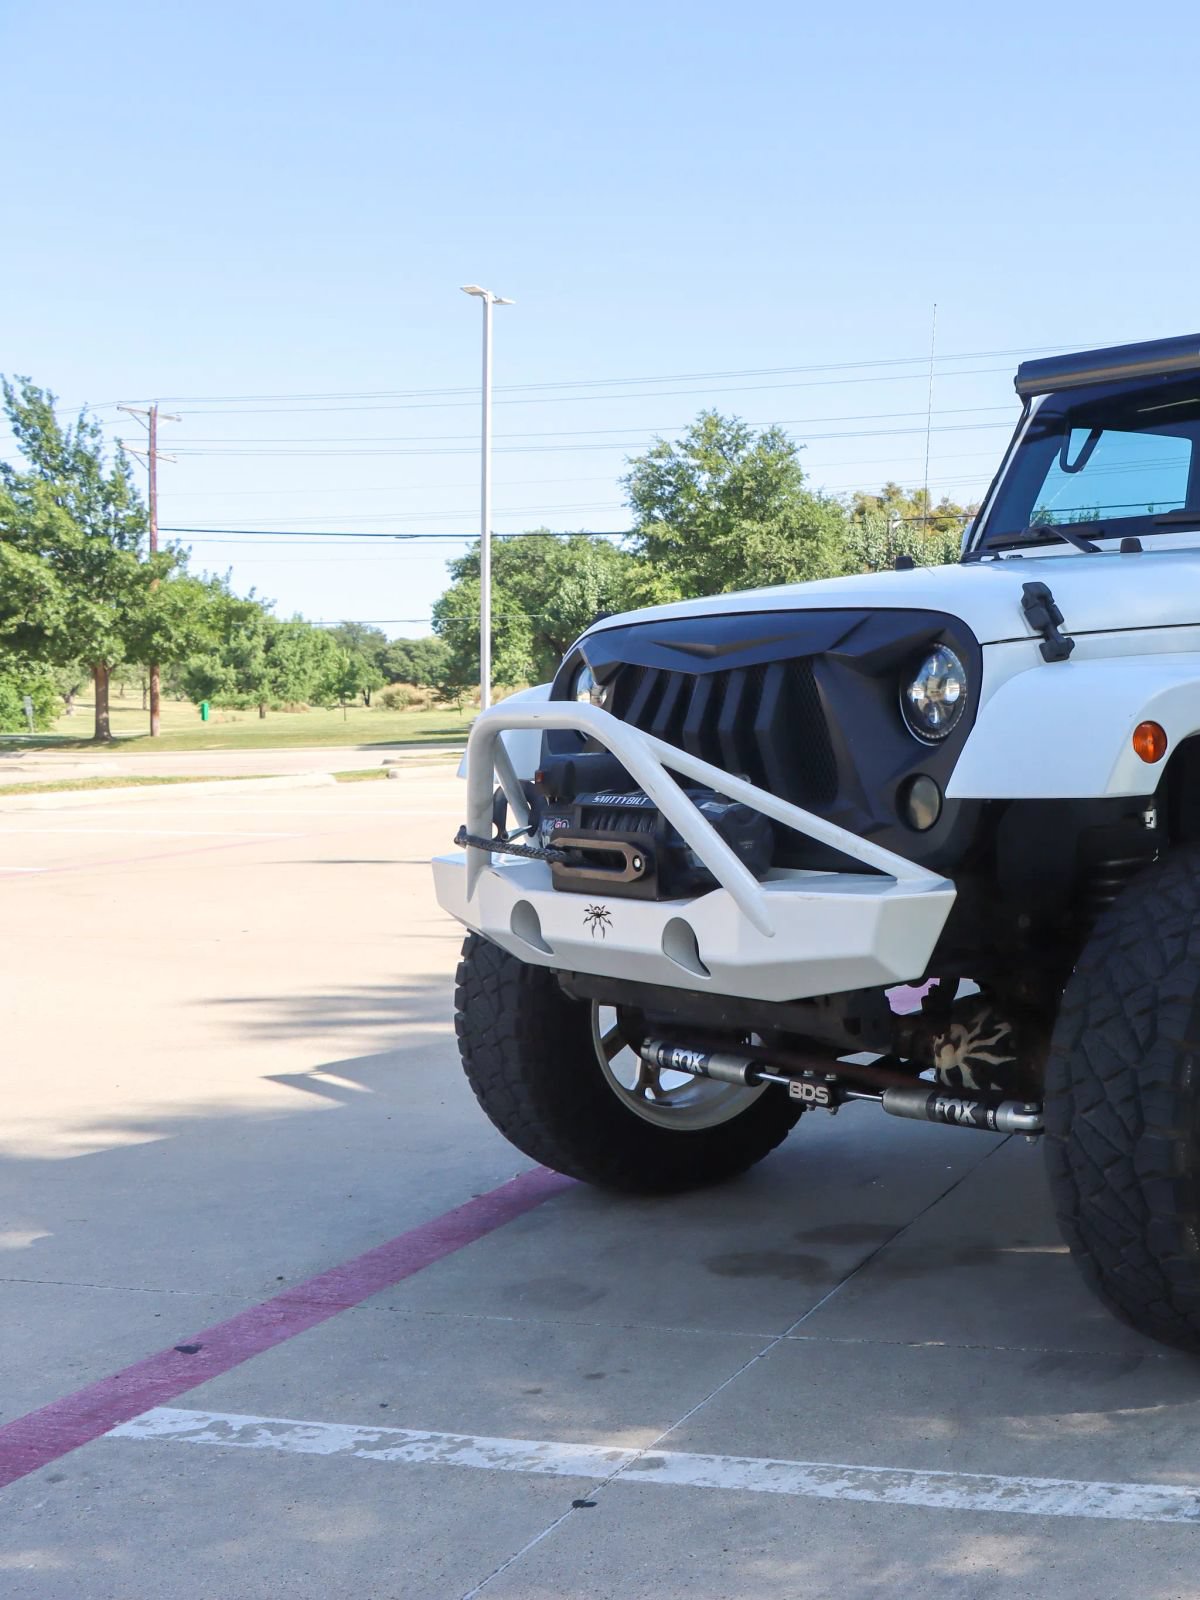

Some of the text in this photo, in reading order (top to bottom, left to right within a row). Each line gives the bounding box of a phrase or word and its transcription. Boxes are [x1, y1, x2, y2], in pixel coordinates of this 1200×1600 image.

[592, 795, 649, 806] SMITTYBILT
[672, 1048, 705, 1073] FOX
[789, 1081, 829, 1104] BDS
[935, 1097, 979, 1125] FOX
